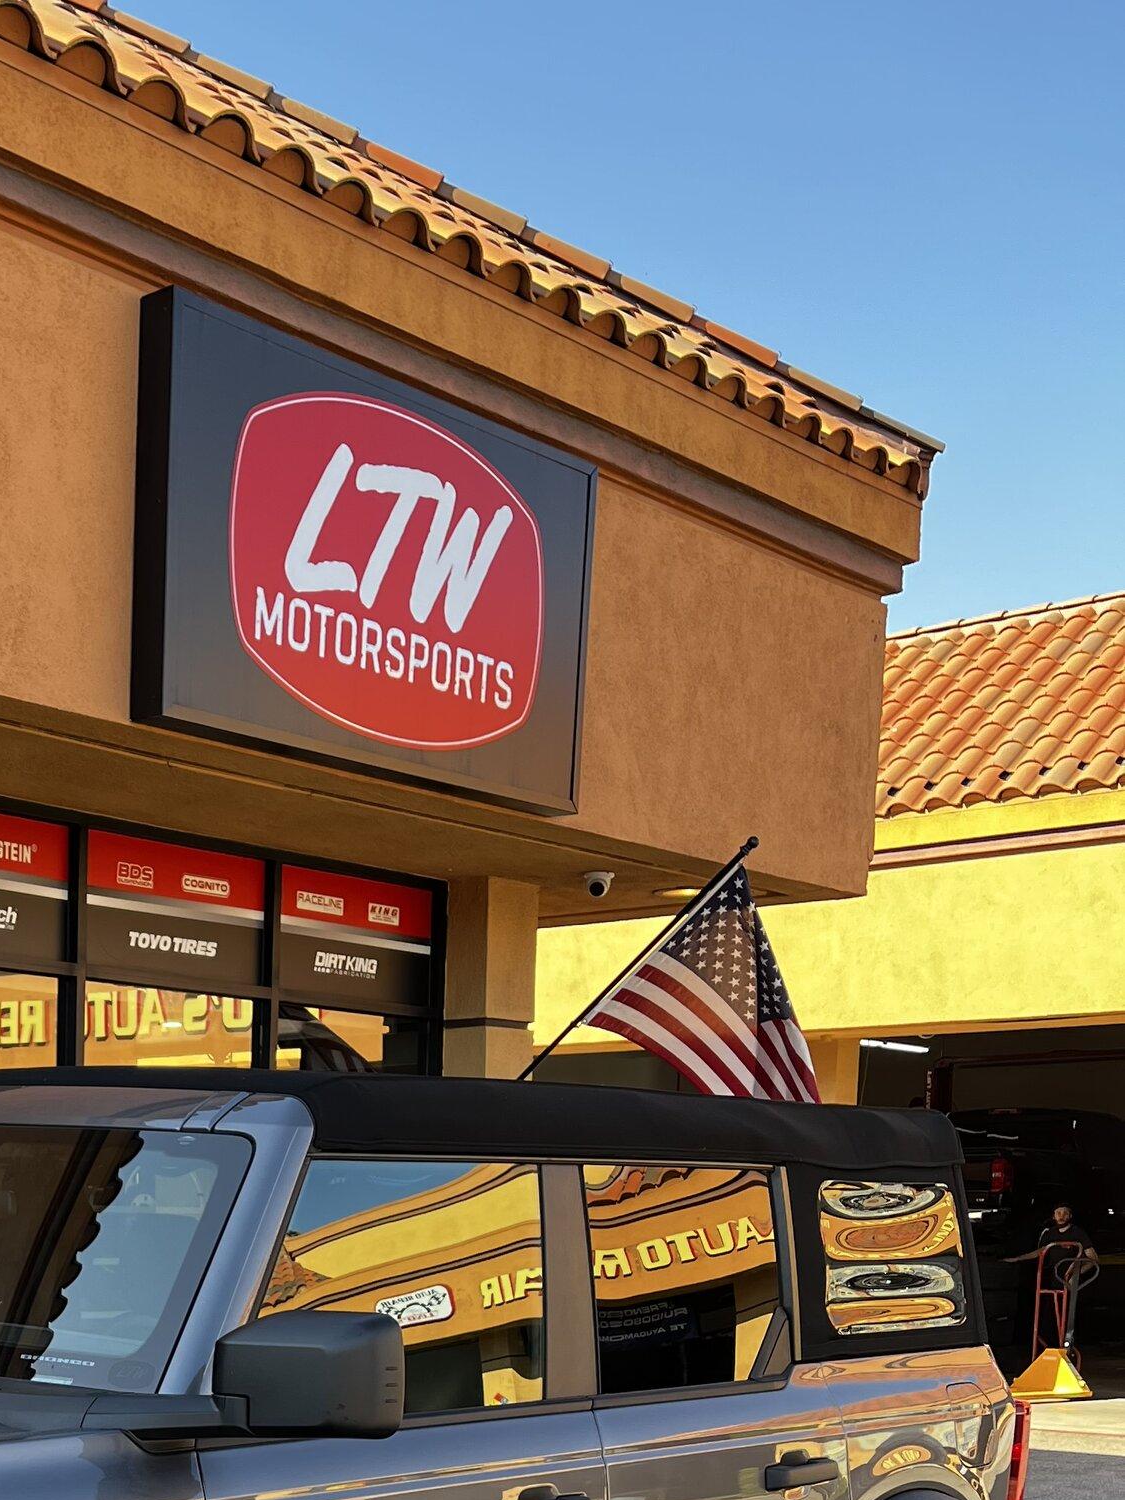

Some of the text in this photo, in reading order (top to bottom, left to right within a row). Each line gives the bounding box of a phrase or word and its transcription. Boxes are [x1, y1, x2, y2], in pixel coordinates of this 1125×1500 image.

[284, 443, 514, 633] LTW
[255, 586, 515, 709] MOTORSPORTS
[117, 862, 153, 881] BDS
[184, 878, 228, 892] COGNITO
[298, 892, 342, 909] RACELINE
[370, 904, 398, 917] KING
[128, 931, 218, 958] TOYO TIRES
[315, 951, 346, 970] DIRT
[345, 955, 378, 974] KING
